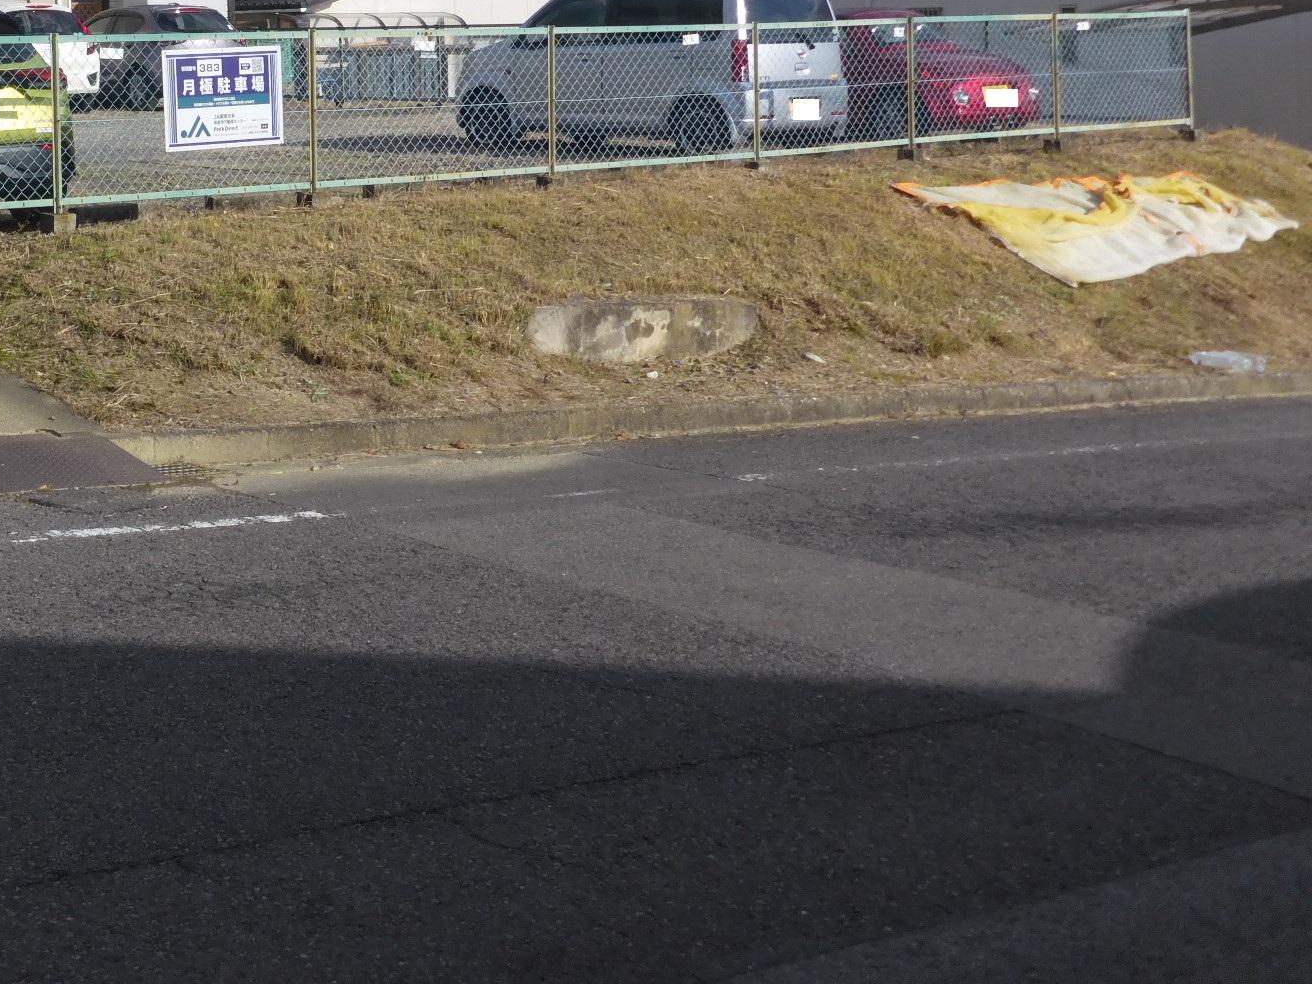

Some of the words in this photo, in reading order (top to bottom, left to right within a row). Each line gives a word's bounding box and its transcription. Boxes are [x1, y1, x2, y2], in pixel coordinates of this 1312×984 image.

[200, 64, 220, 72] 383
[183, 76, 264, 96] 月極駐車場
